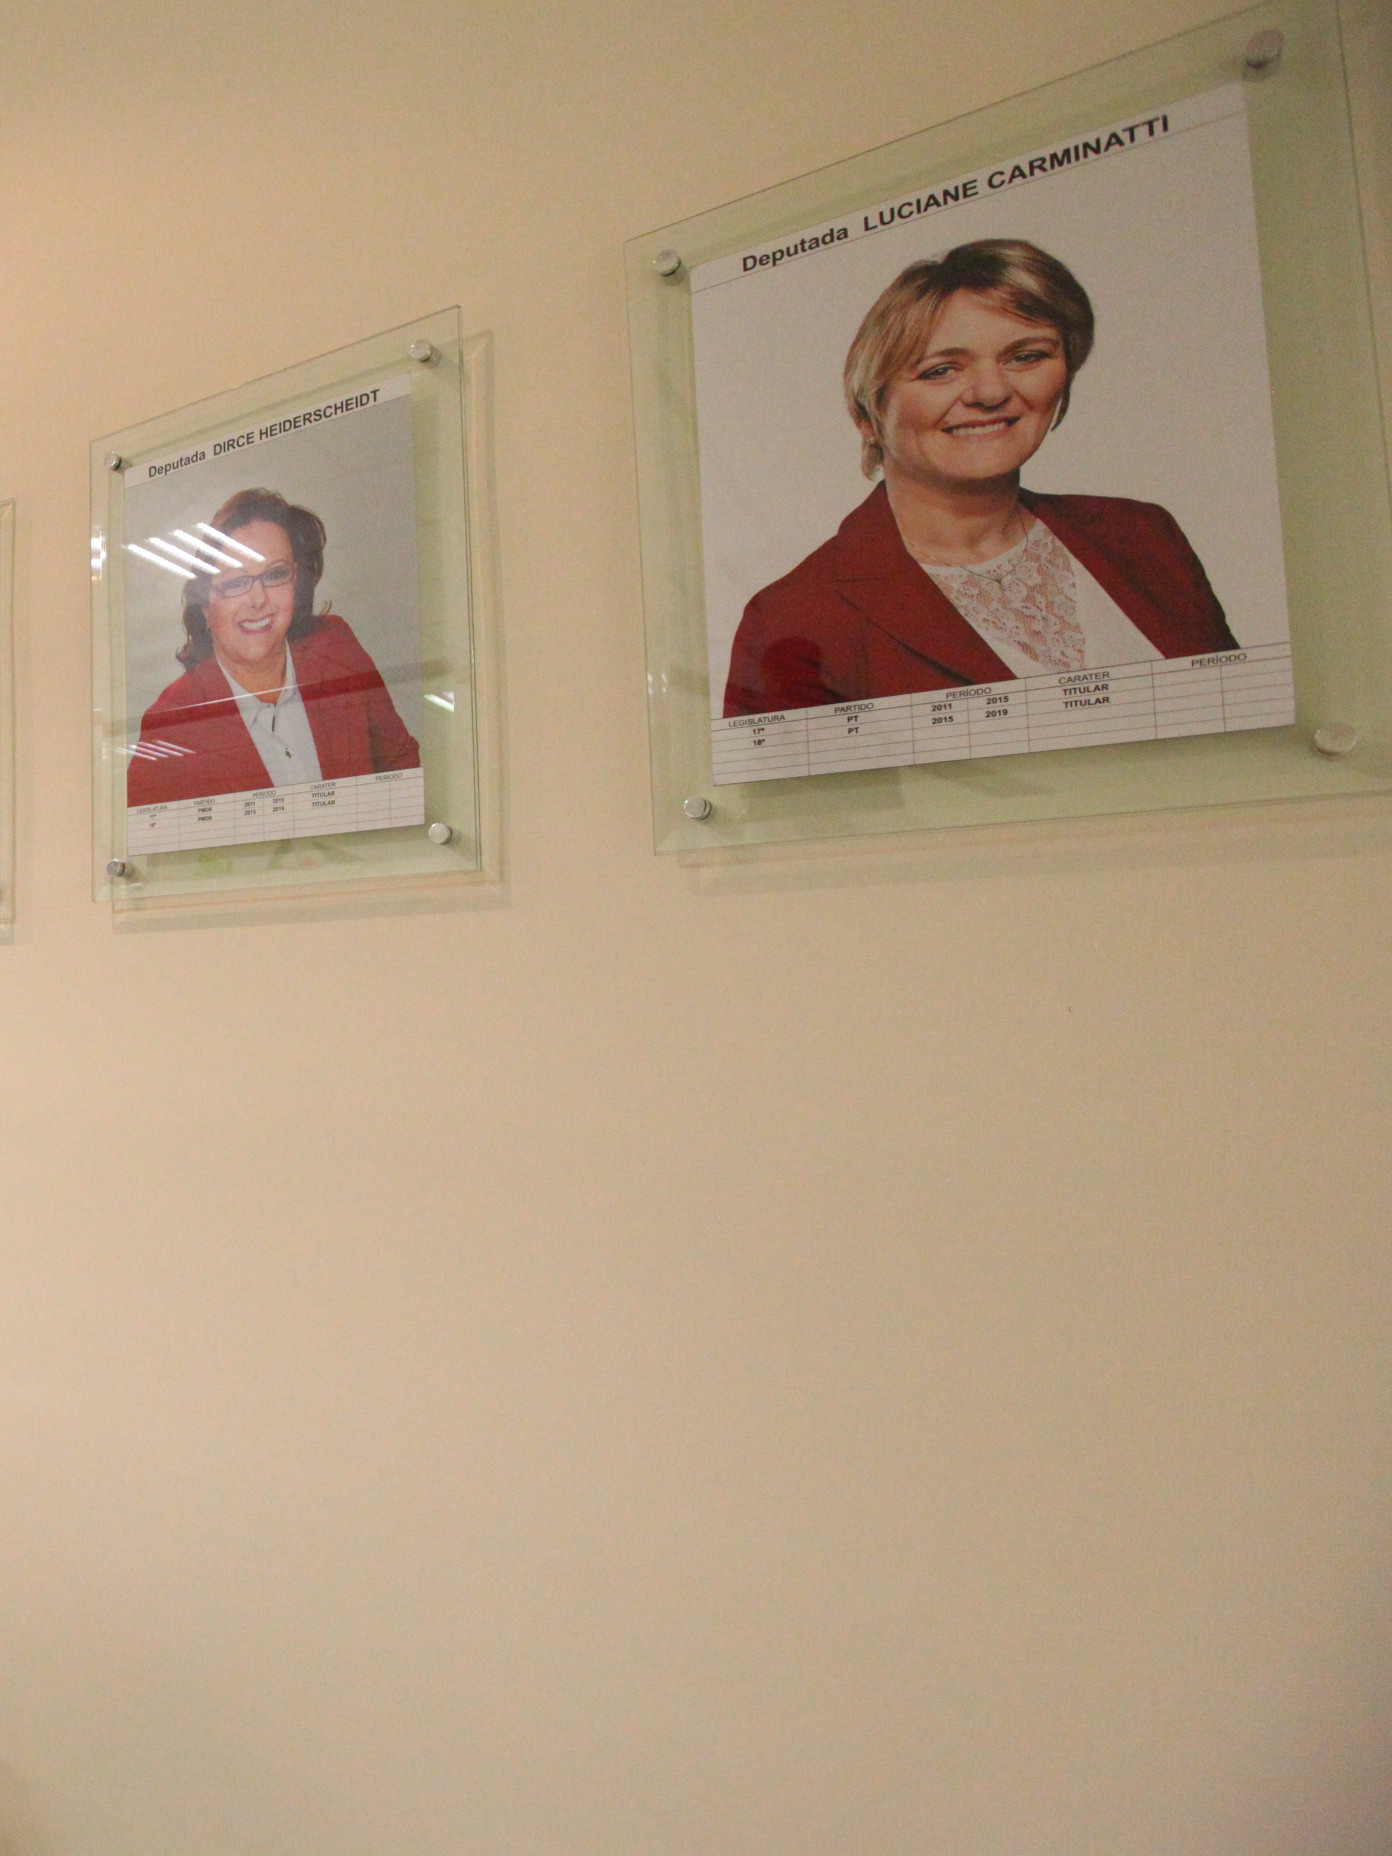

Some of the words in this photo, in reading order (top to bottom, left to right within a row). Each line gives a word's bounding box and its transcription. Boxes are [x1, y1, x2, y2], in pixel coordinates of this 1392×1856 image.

[741, 226, 849, 273] Deputada
[863, 178, 979, 233] LUCIANE
[986, 113, 1170, 190] CARMINATTI
[148, 450, 206, 478] Deputada
[213, 431, 255, 456] DIRCE
[259, 388, 380, 441] HEIDERSCHEIDT
[728, 714, 786, 728] LEGISLATURA
[834, 702, 874, 714] PARTIDO
[945, 686, 992, 699] PERÍODO
[1058, 671, 1111, 685] CARATER
[1190, 652, 1248, 667] PERÍODO
[847, 715, 859, 723] PT
[931, 703, 953, 712] 2011
[986, 695, 1010, 705] 2015
[1062, 683, 1109, 696] TITULAR
[848, 726, 860, 734] PT
[932, 715, 954, 725] 2015
[985, 708, 1008, 718] 2019
[1063, 696, 1111, 709] TITULAR
[309, 782, 336, 791] CARATER
[311, 790, 336, 799] TITULAR
[311, 800, 336, 808] TITULAR
